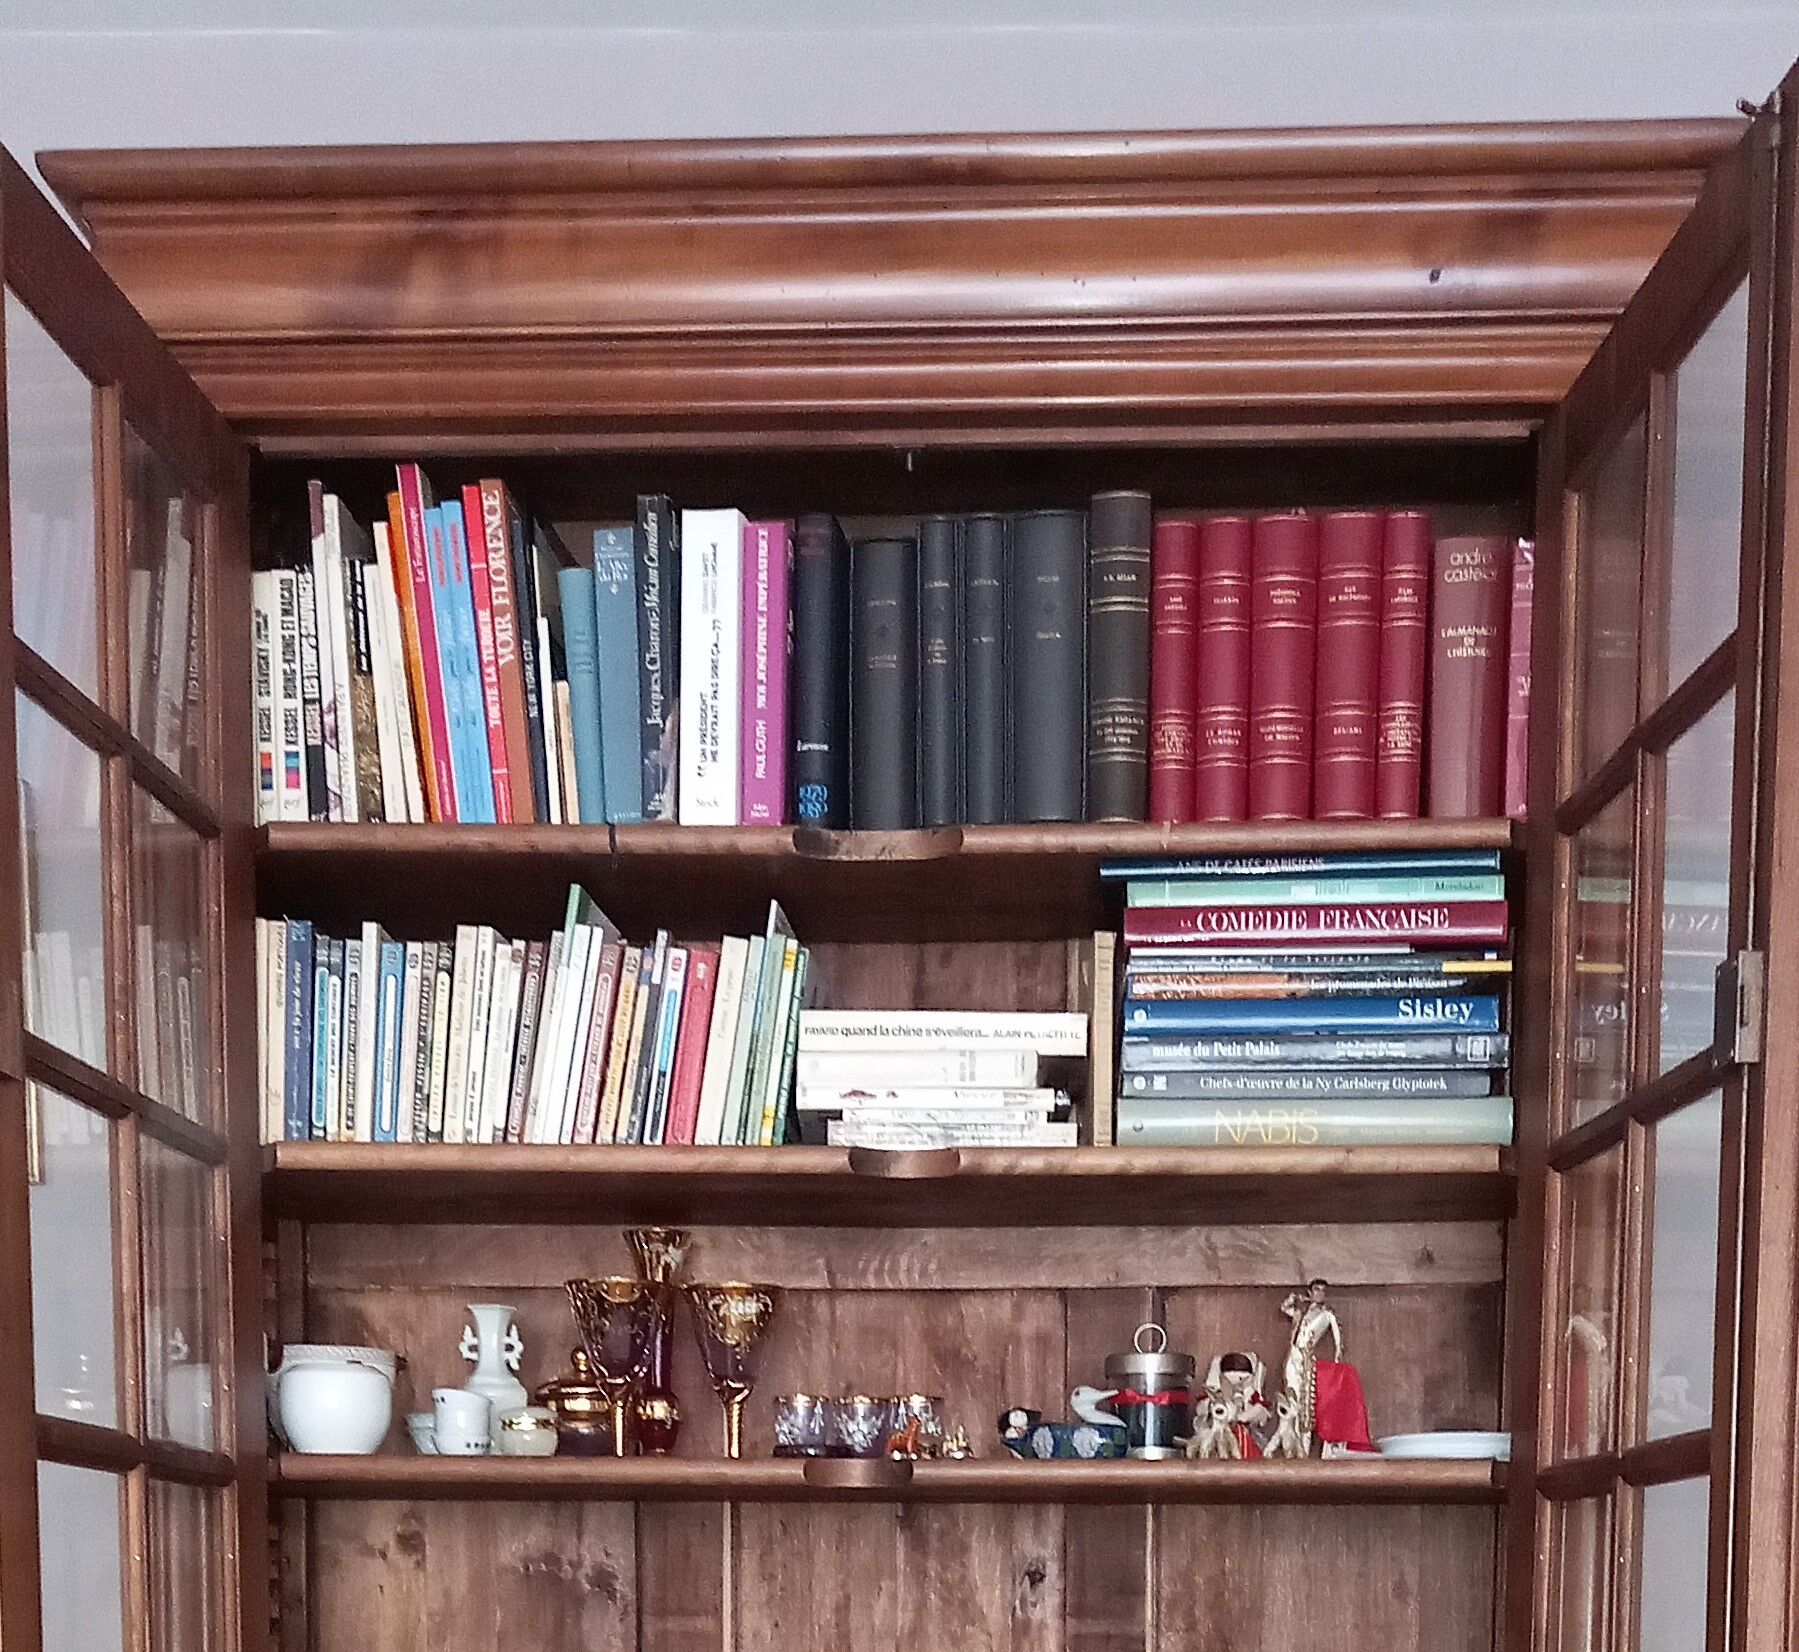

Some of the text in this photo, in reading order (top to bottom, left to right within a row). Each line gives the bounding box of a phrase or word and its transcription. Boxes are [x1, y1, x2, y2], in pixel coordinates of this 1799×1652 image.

[482, 490, 516, 668] VOIR FLORENCE
[483, 667, 497, 683] LA
[485, 687, 502, 729] TOUTE
[283, 707, 298, 746] KESSEL
[1317, 906, 1451, 933] FRANÇAISE
[1397, 997, 1475, 1025] Sisley
[841, 1023, 878, 1039] quand
[880, 1024, 889, 1036] la
[1151, 1040, 1281, 1057] musée du Petit Palais
[1285, 1075, 1300, 1090] de
[1301, 1075, 1314, 1090] la
[1314, 1075, 1333, 1094] Ny
[1333, 1075, 1391, 1094] Carlsberg
[1391, 1074, 1449, 1094] Glyptotek
[1213, 1107, 1319, 1146] NABIS
